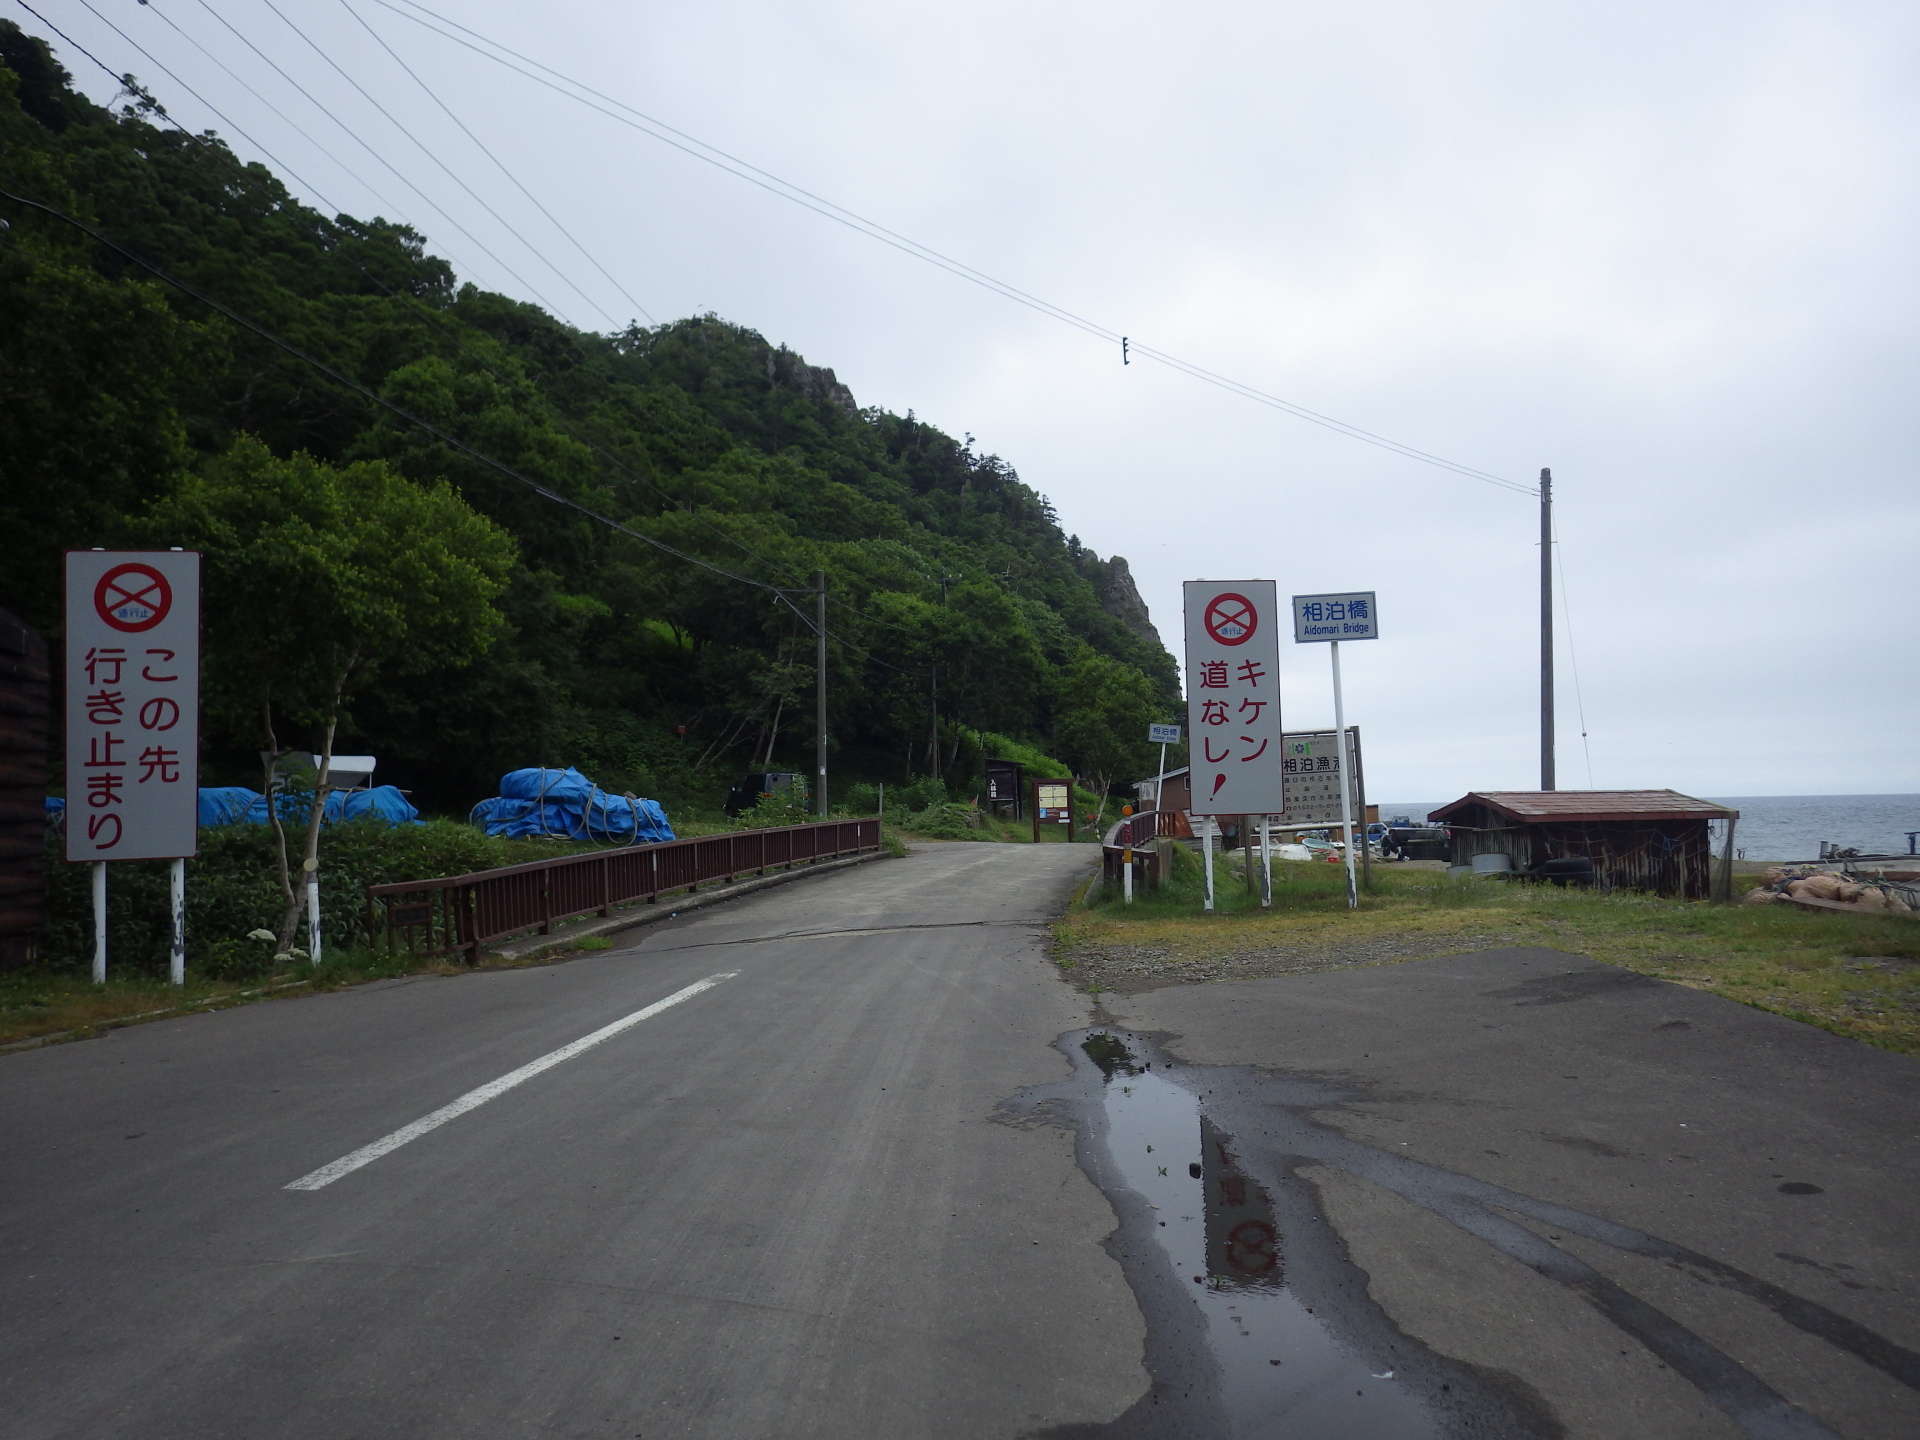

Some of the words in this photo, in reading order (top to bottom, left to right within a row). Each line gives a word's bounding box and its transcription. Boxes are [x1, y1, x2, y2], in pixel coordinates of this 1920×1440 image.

[118, 608, 150, 618] 通行止
[1221, 627, 1243, 635] 通行止
[1302, 600, 1368, 622] 相泊橋
[1304, 624, 1340, 635] Aidomari
[1343, 623, 1369, 634] Bridge
[139, 648, 180, 784] この先
[1200, 660, 1230, 802] 道なし!
[1237, 659, 1268, 763] キケン
[84, 647, 128, 850] 行き止まり
